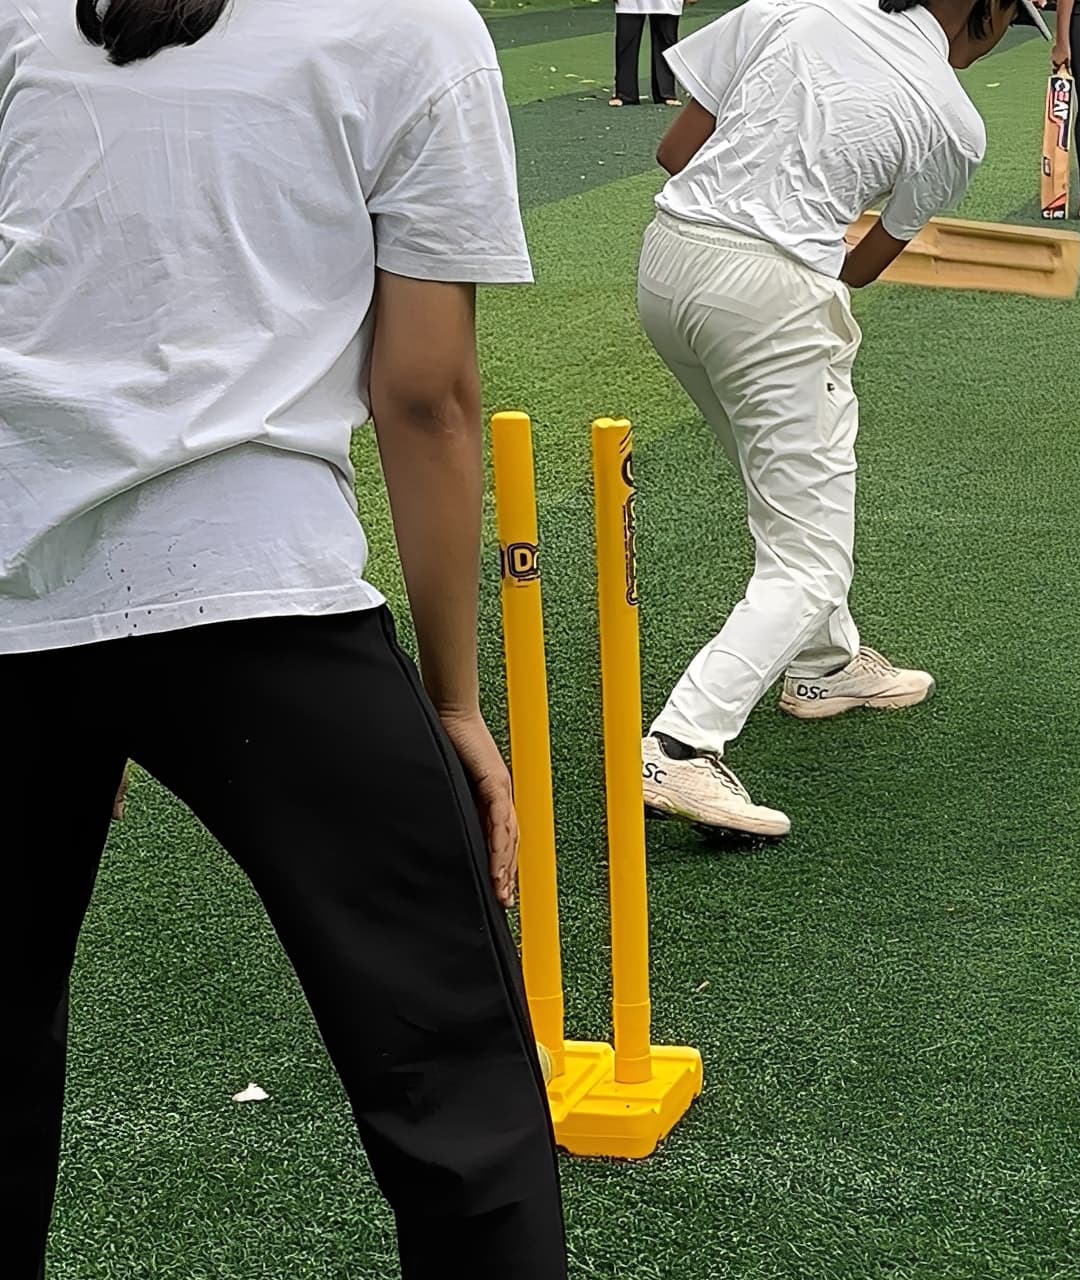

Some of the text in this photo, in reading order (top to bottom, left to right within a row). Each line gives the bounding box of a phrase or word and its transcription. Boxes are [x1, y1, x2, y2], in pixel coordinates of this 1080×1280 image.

[1053, 79, 1071, 120] CEAT
[796, 684, 829, 699] DSC
[642, 762, 667, 784] SC
